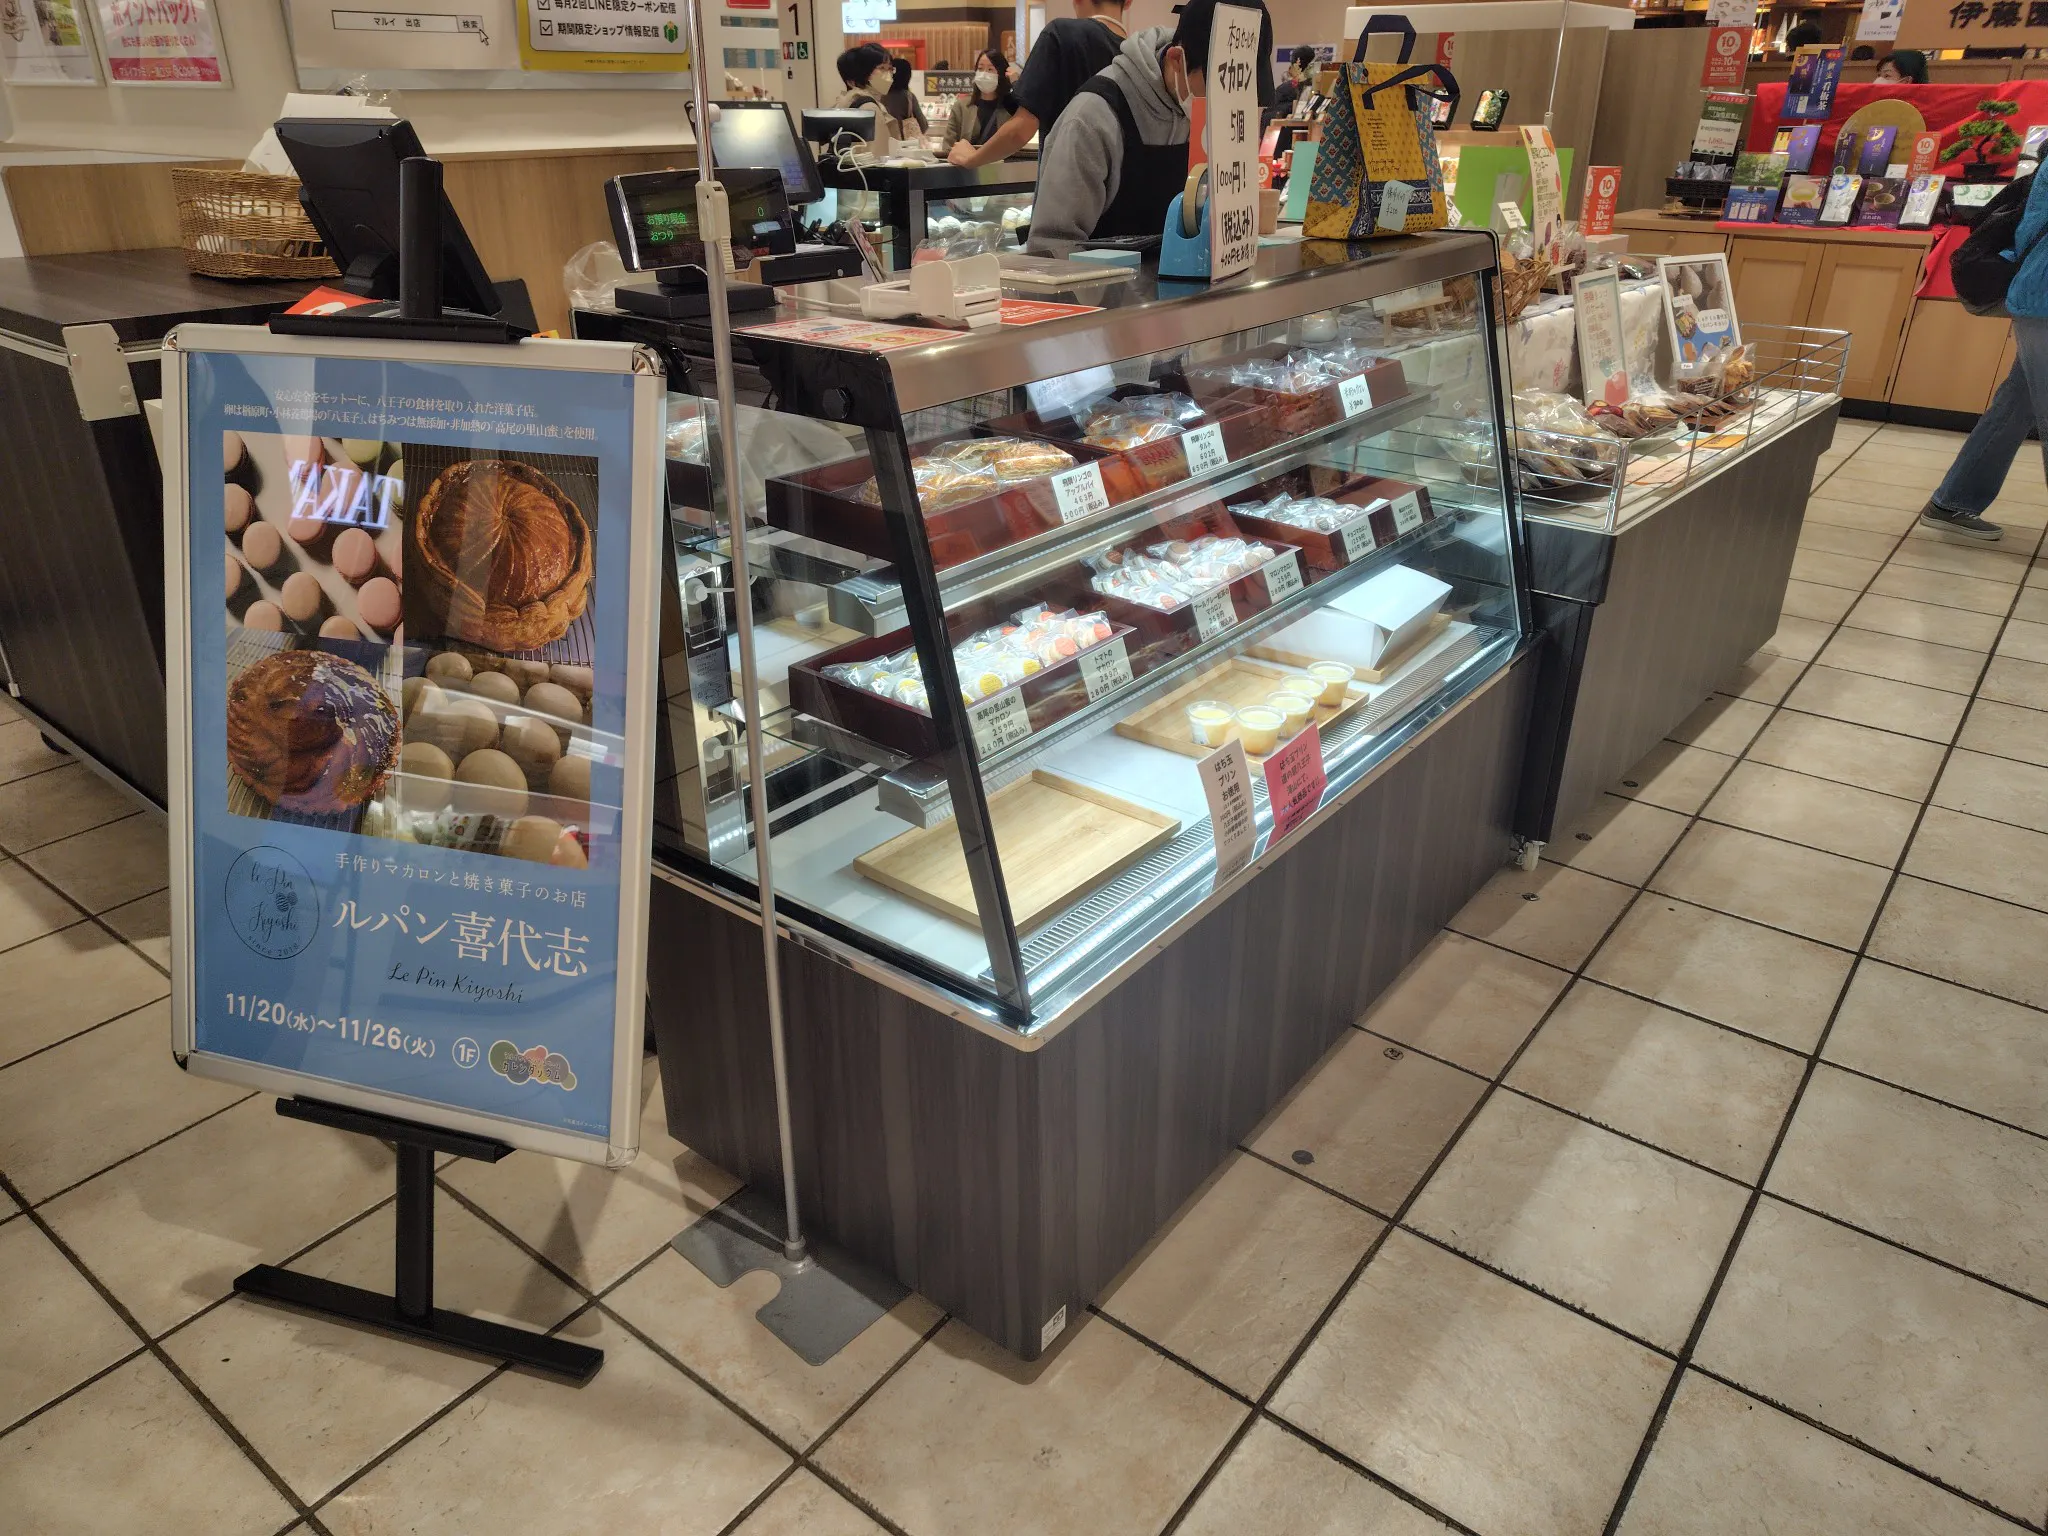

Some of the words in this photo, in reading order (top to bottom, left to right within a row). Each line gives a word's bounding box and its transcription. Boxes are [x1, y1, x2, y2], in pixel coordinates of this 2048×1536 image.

[373, 17, 396, 27] マルイ
[405, 18, 421, 28] 出店
[462, 20, 479, 29] 検索
[788, 3, 799, 36] 1
[557, 22, 660, 38] 期間限定ショップ情報配信
[1218, 58, 1252, 93] マカロン
[1230, 109, 1244, 143] 5個
[1216, 161, 1246, 194] 1000円!
[646, 212, 686, 226] お預り現金
[1221, 205, 1254, 246] (税込み)
[651, 231, 674, 241] おつり
[274, 389, 538, 418] 安心安全をモットーに、八王子の食材を取り入れた洋菓子店。
[1199, 441, 1211, 450] タルト
[1065, 480, 1094, 497] アップルパイ
[1074, 491, 1094, 504] 463円
[1064, 506, 1085, 520] 500円
[1086, 497, 1105, 512] (税込み)
[1206, 602, 1222, 615] マカロン
[1094, 649, 1113, 665] トマトの
[1096, 660, 1115, 673] マカロン
[1100, 667, 1118, 683] 259円
[1090, 683, 1110, 699] 280円
[976, 695, 1016, 721] 高尾の里山蜜の
[988, 710, 1011, 726] マカロン
[991, 719, 1014, 737] 259円
[980, 736, 1004, 755] 280円
[1005, 724, 1028, 742] (税込み)
[1214, 753, 1234, 773] はち玉
[1279, 742, 1308, 771] はち玉プリン
[1218, 769, 1237, 787] プリン
[334, 852, 587, 909] 手作りマカロンと焼き菓子のお店
[332, 900, 590, 977] ルパン喜代志
[387, 962, 410, 982] Le
[415, 965, 446, 989] Pin
[452, 974, 524, 1003] Kiyoshi
[458, 1043, 477, 1063] 1F
[502, 1061, 561, 1081] カレンダリウム
